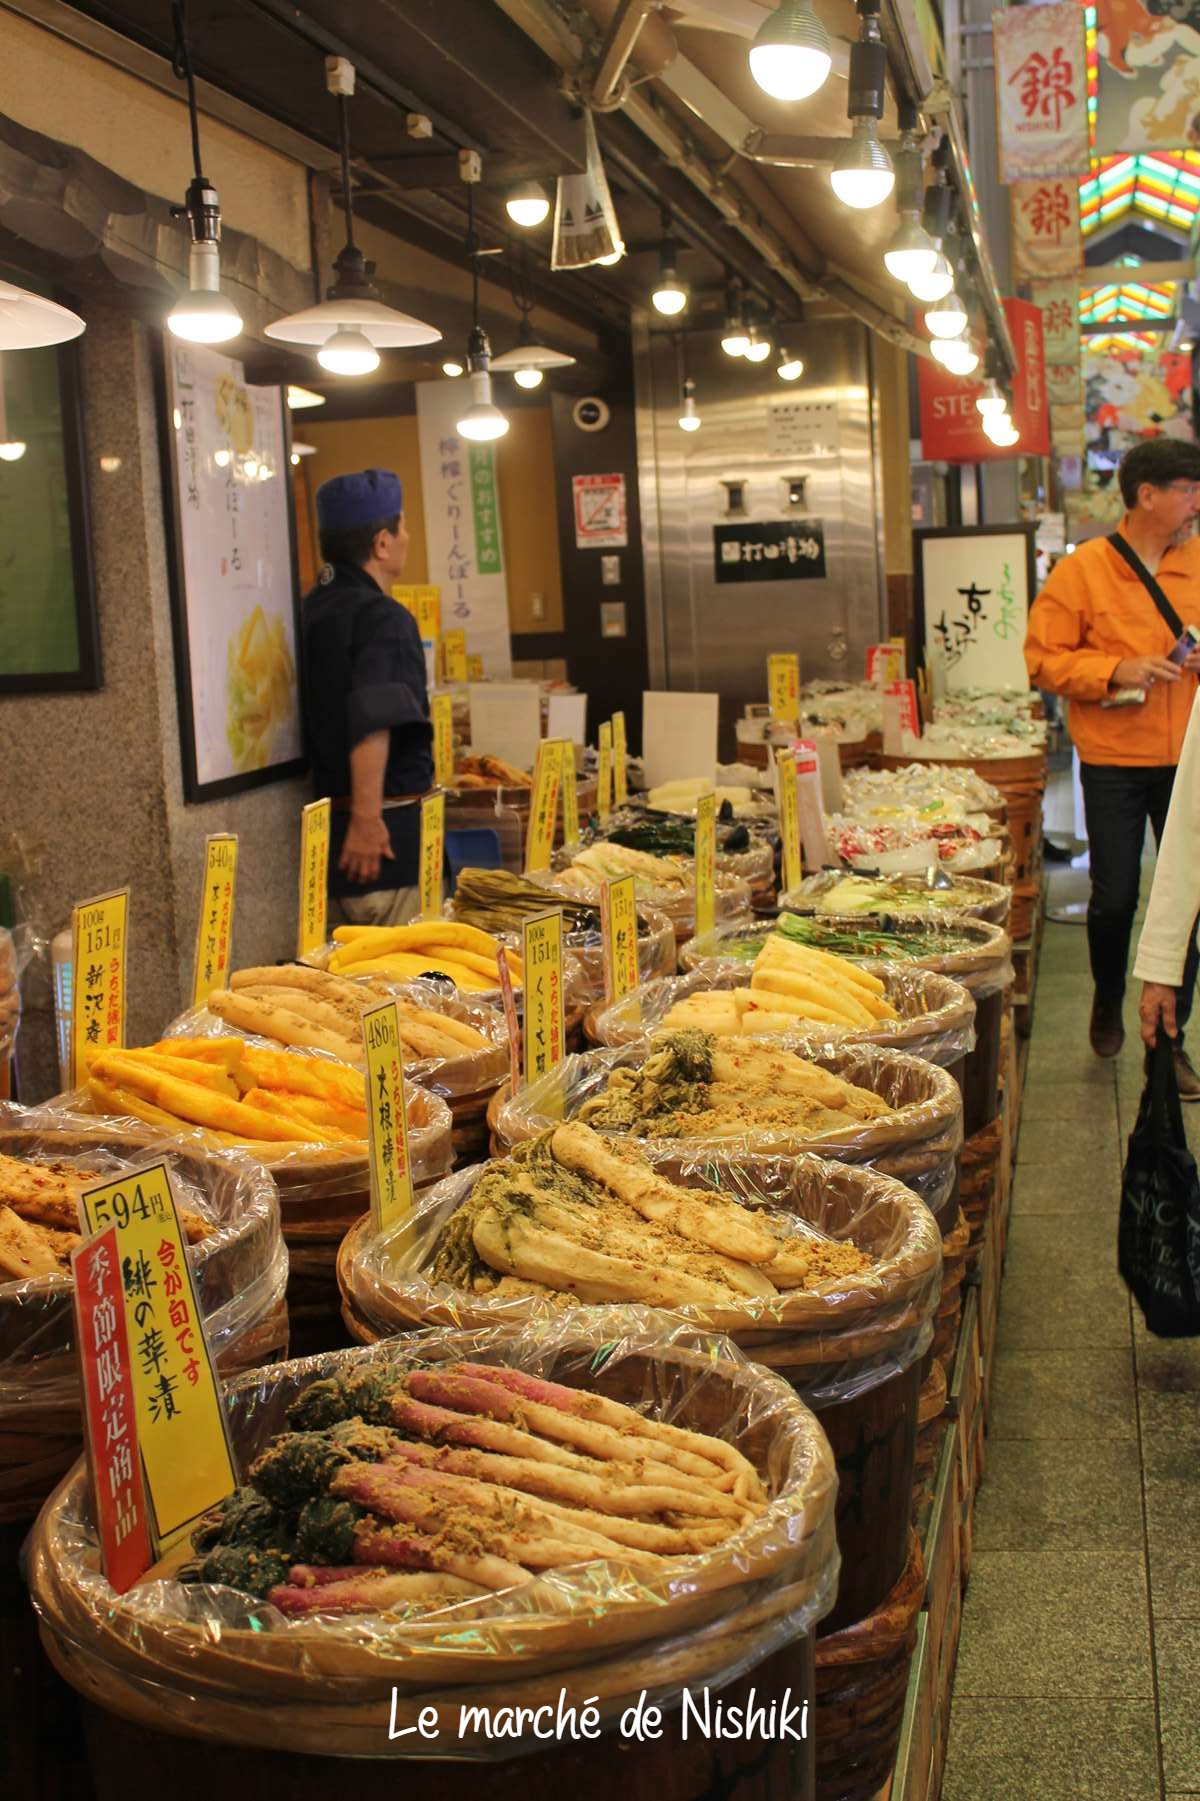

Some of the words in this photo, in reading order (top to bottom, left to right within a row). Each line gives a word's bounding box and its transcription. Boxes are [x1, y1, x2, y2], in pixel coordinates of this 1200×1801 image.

[1008, 46, 1076, 132] 錦
[1021, 183, 1071, 245] 錦
[157, 1239, 200, 1386] 今が旬です
[88, 1245, 139, 1547] 季節限定商品
